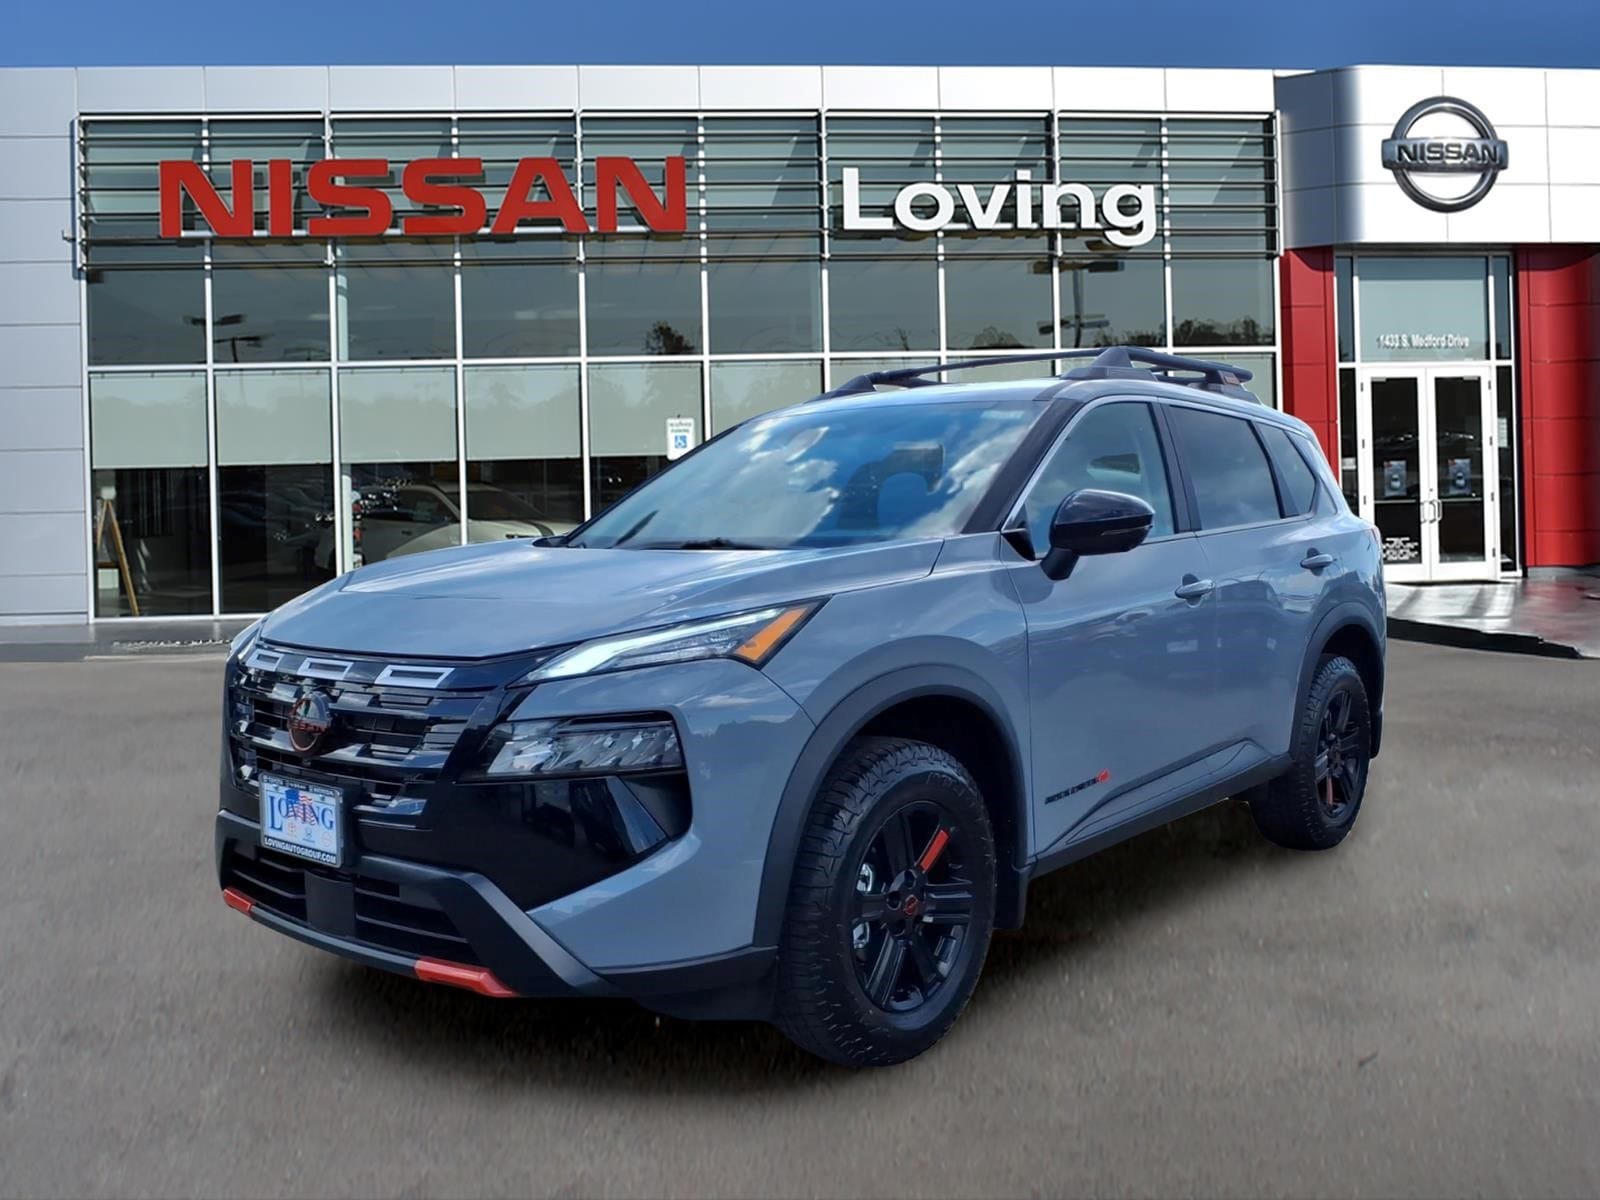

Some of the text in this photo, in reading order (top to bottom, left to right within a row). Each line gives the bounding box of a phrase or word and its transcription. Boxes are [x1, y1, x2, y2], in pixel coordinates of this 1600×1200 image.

[1397, 142, 1498, 163] NISSAN
[159, 156, 687, 238] NISSAN
[842, 167, 1157, 247] Loving
[1379, 334, 1399, 348] 1433
[1411, 333, 1446, 348] Medford
[1447, 333, 1470, 348] Drive
[269, 795, 334, 832] LOVING
[264, 837, 337, 864] LOVINGAUTOGROUP.COM
